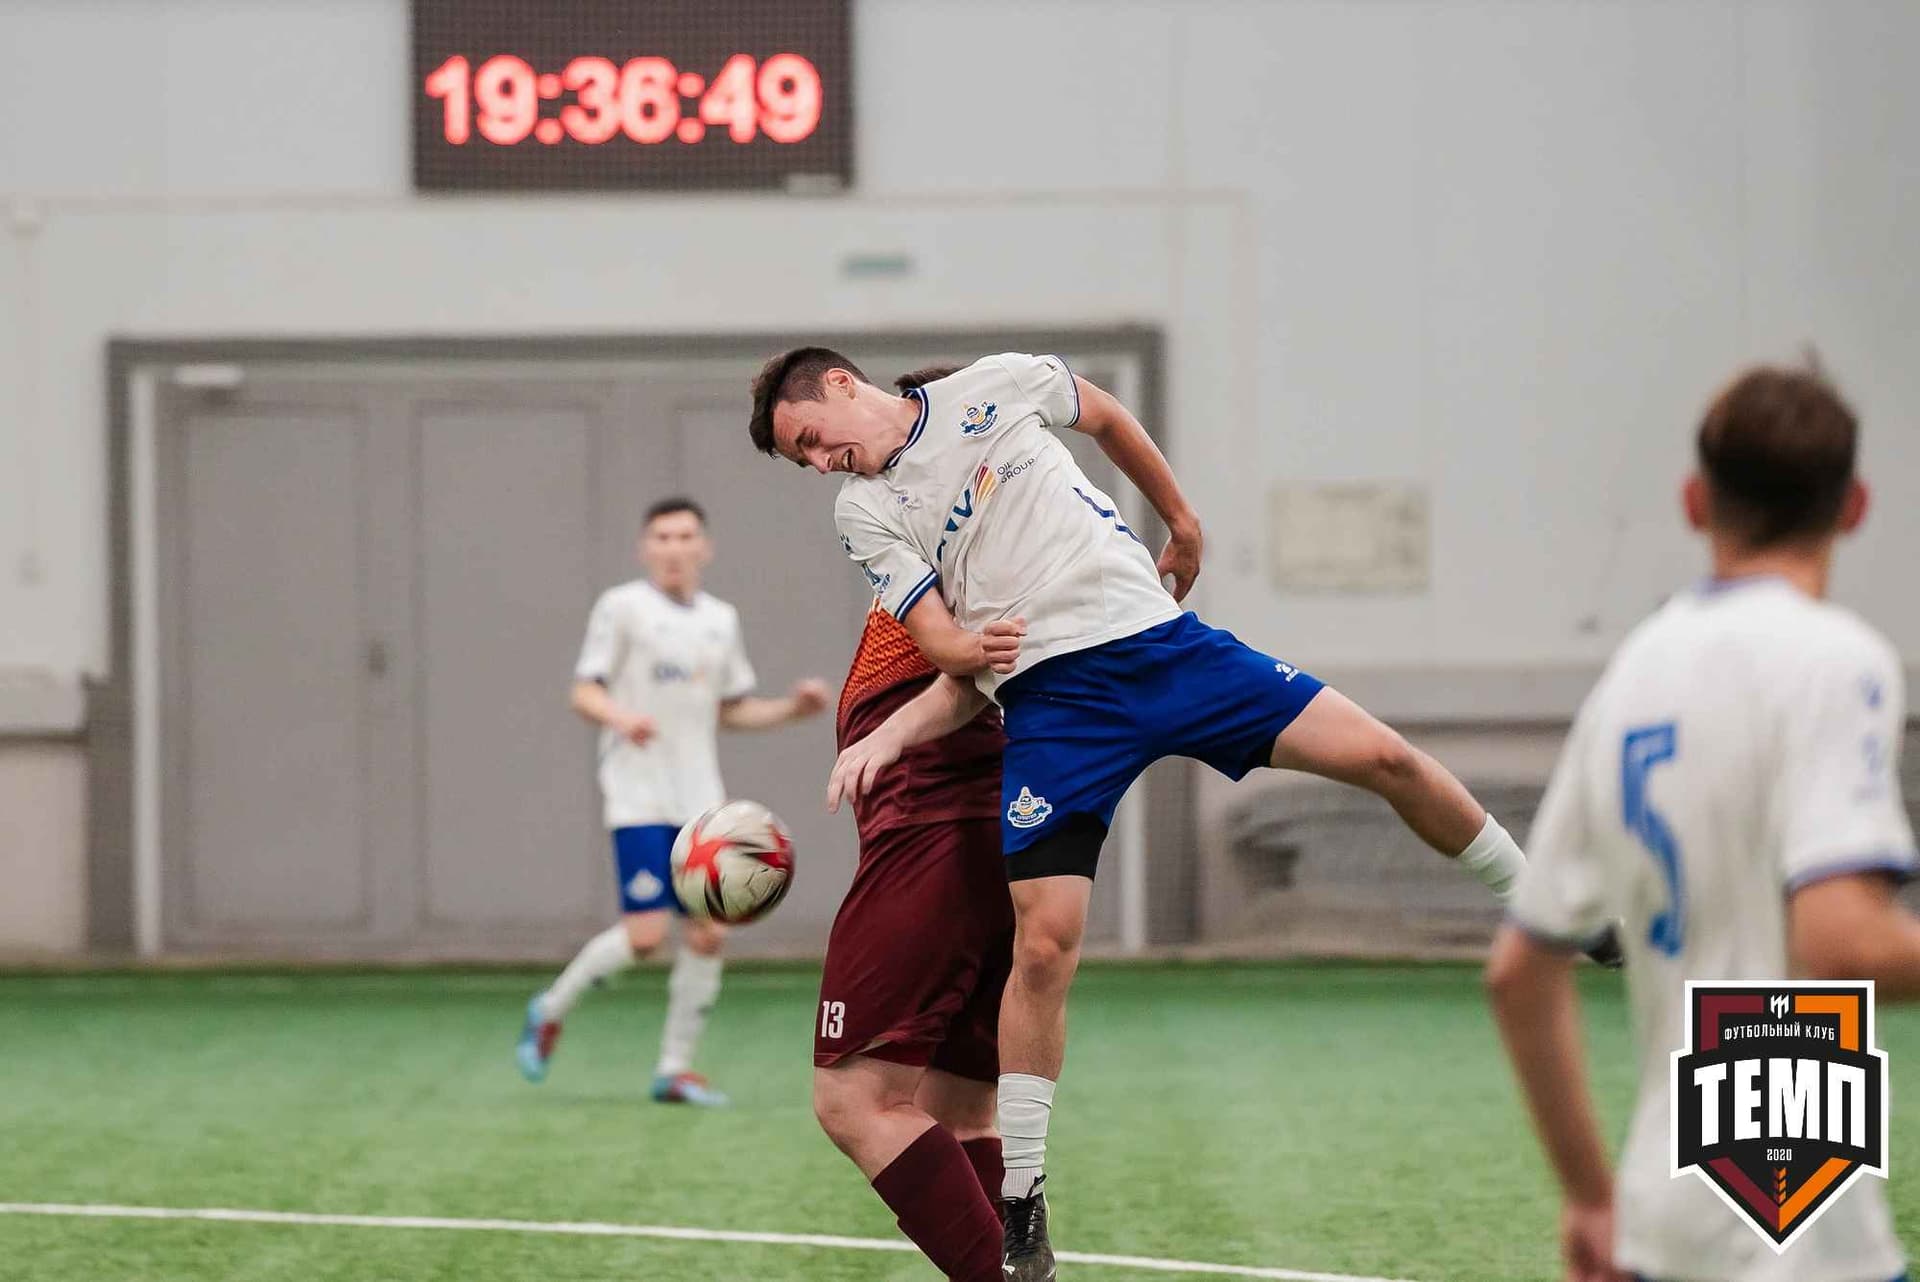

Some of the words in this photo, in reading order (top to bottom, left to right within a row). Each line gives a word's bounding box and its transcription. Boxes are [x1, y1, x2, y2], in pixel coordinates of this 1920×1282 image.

[425, 53, 823, 145] 19:36:49
[997, 461, 1013, 475] OIL
[1621, 721, 1688, 957] 5
[821, 1000, 846, 1039] 13
